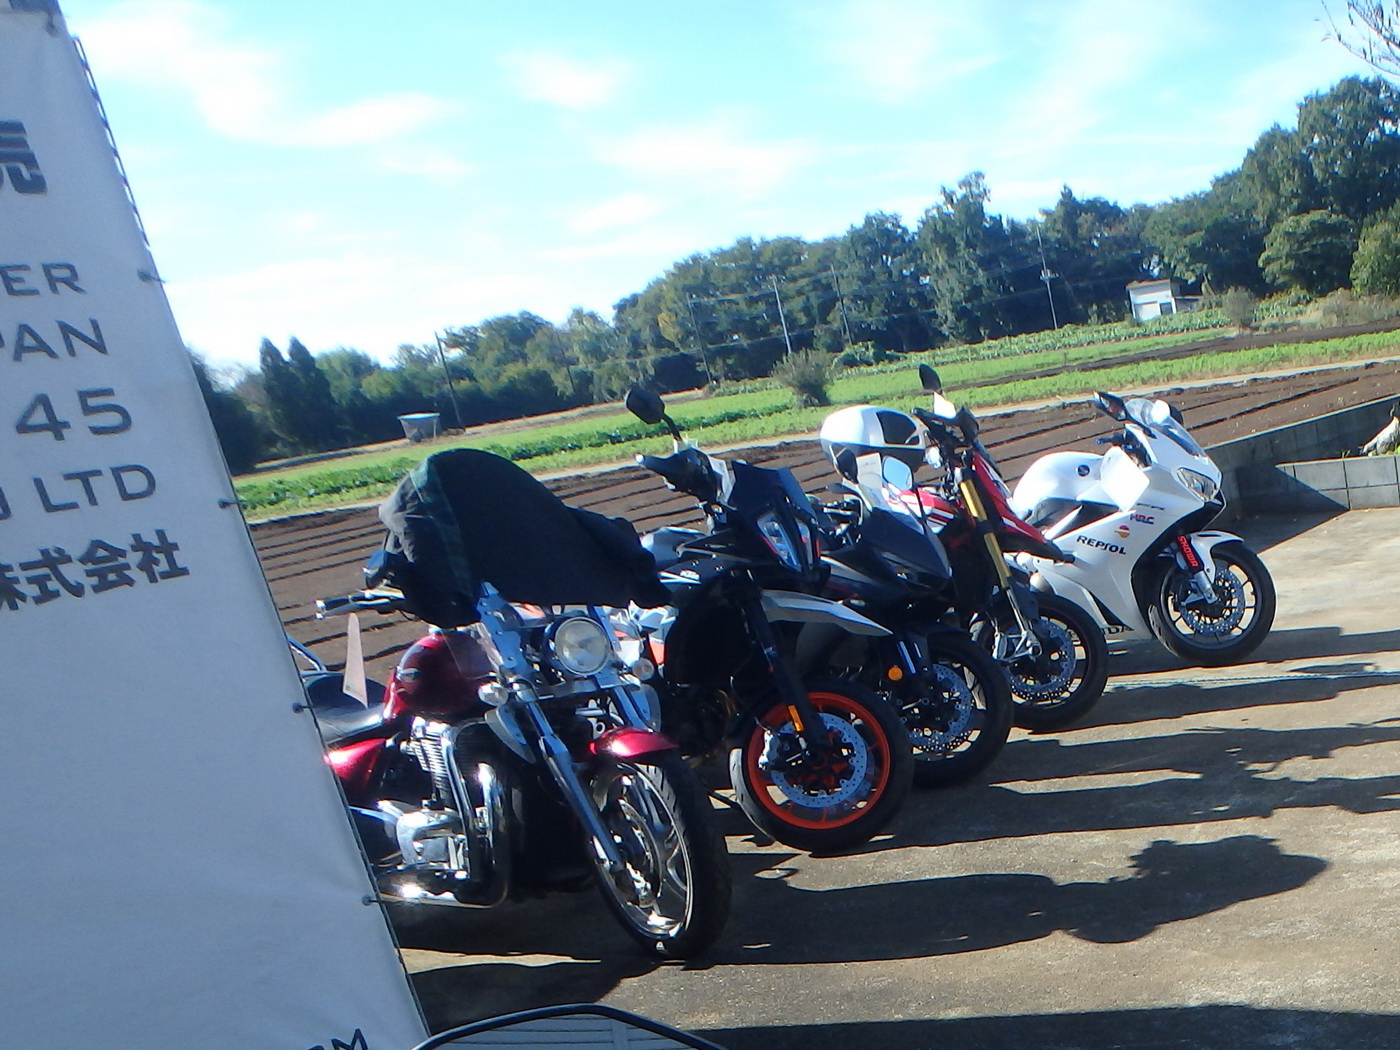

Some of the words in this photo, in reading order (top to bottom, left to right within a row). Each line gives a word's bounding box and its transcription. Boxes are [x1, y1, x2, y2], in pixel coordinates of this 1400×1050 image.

[0, 317, 110, 362] AN
[15, 387, 133, 442] 45
[33, 463, 157, 513] LTD
[1076, 534, 1127, 556] REPSOL
